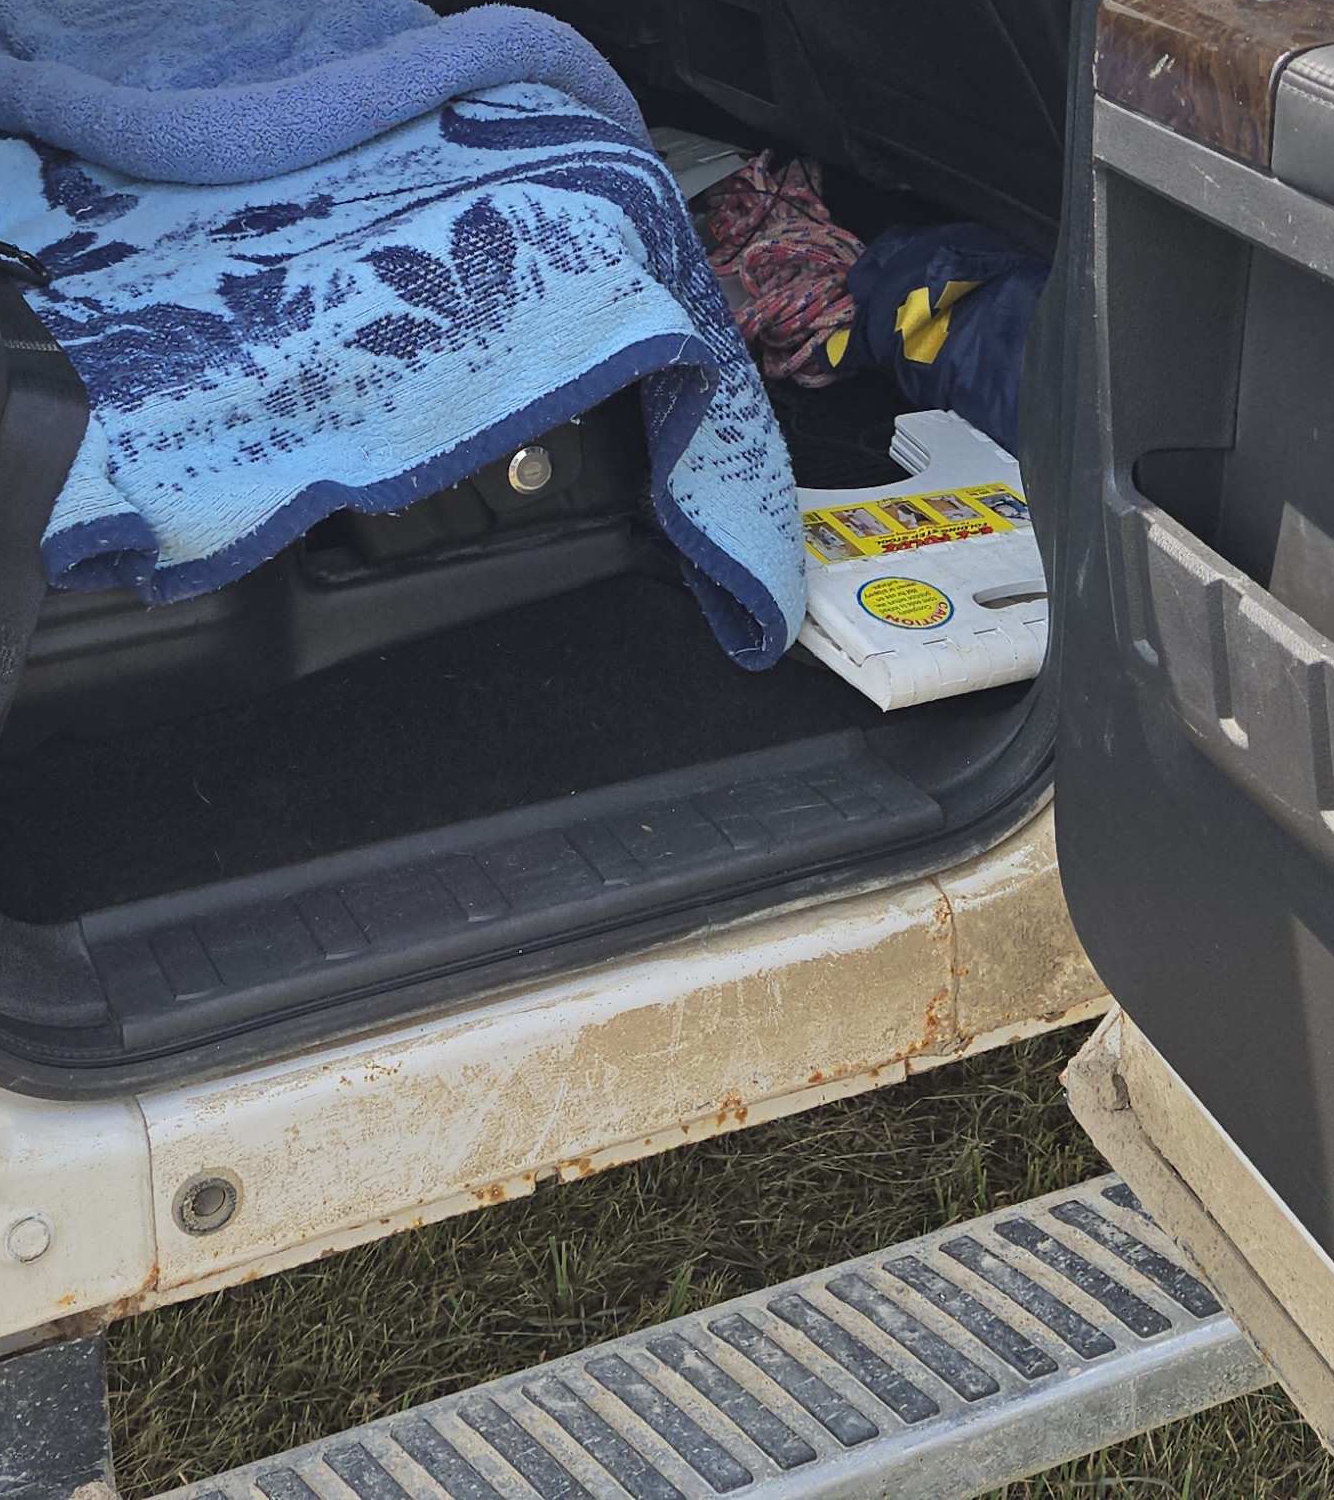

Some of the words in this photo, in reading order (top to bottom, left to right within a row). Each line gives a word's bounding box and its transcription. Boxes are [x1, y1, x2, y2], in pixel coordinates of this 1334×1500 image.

[941, 522, 987, 533] FOLDING
[911, 529, 938, 539] STEP
[876, 535, 909, 545] STOOL
[885, 601, 948, 626] CAUTION
